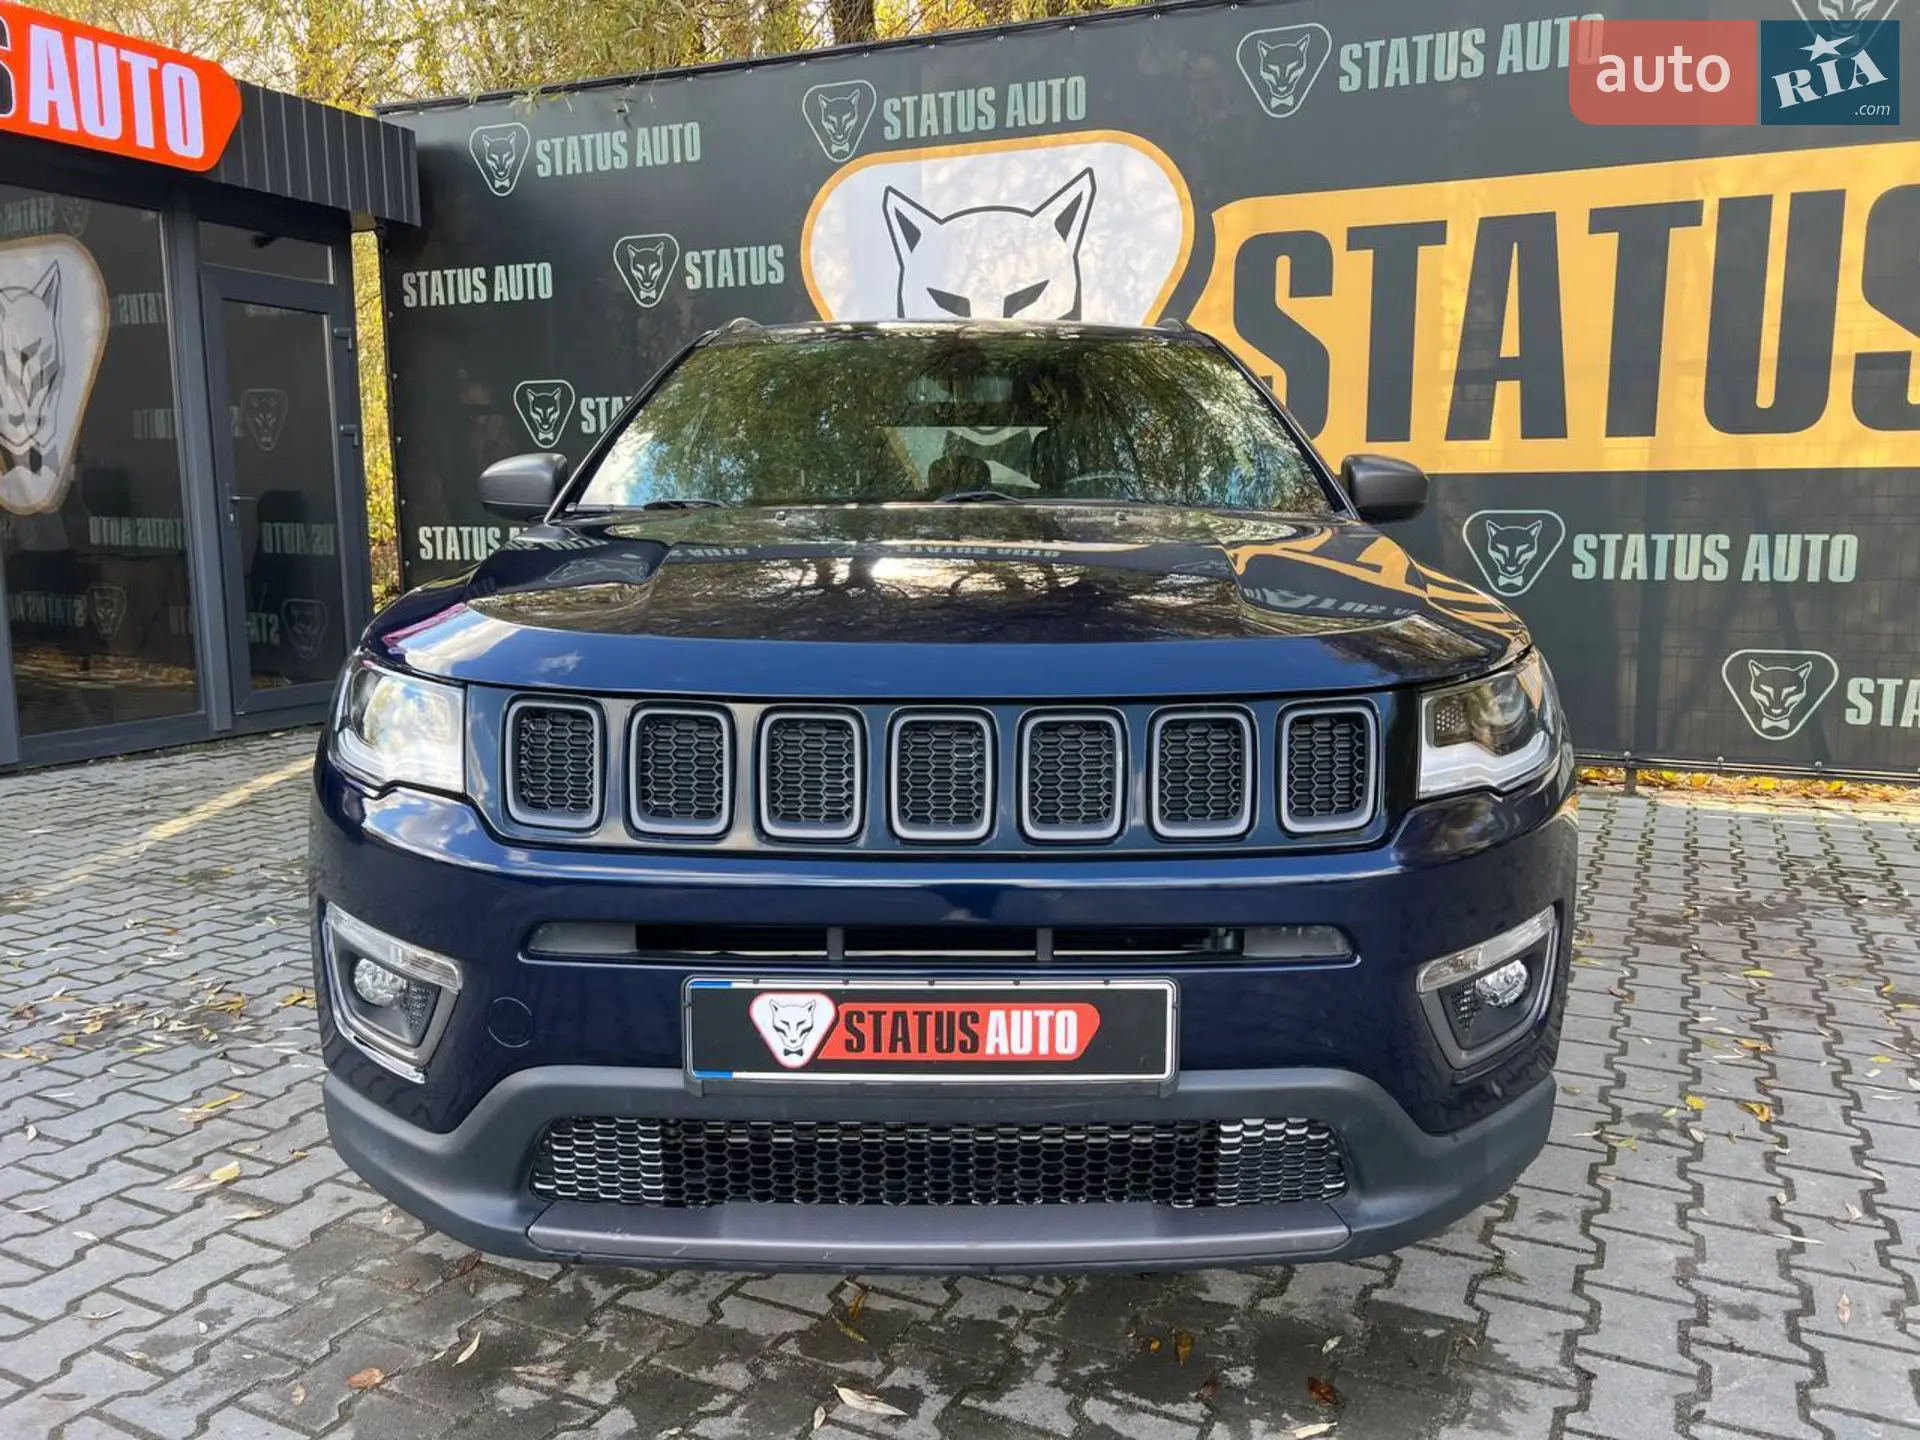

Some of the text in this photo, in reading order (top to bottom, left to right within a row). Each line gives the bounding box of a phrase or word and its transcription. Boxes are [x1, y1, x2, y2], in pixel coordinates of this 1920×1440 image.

[1339, 13, 1604, 92] STATUS AUTO
[28, 23, 205, 158] AUTO
[883, 76, 1086, 140] STATUS AUTO
[536, 122, 701, 178] STATUS AUTO
[402, 262, 553, 308] STATUS AUTO
[685, 244, 785, 290] STATUS
[1234, 184, 1920, 442] STATUS
[580, 395, 633, 434] STA
[418, 526, 501, 560] STATUS
[1571, 534, 1859, 583] STATUS AUTO
[1845, 677, 1920, 728] STA
[845, 1009, 1078, 1055] STATUS AUTO
